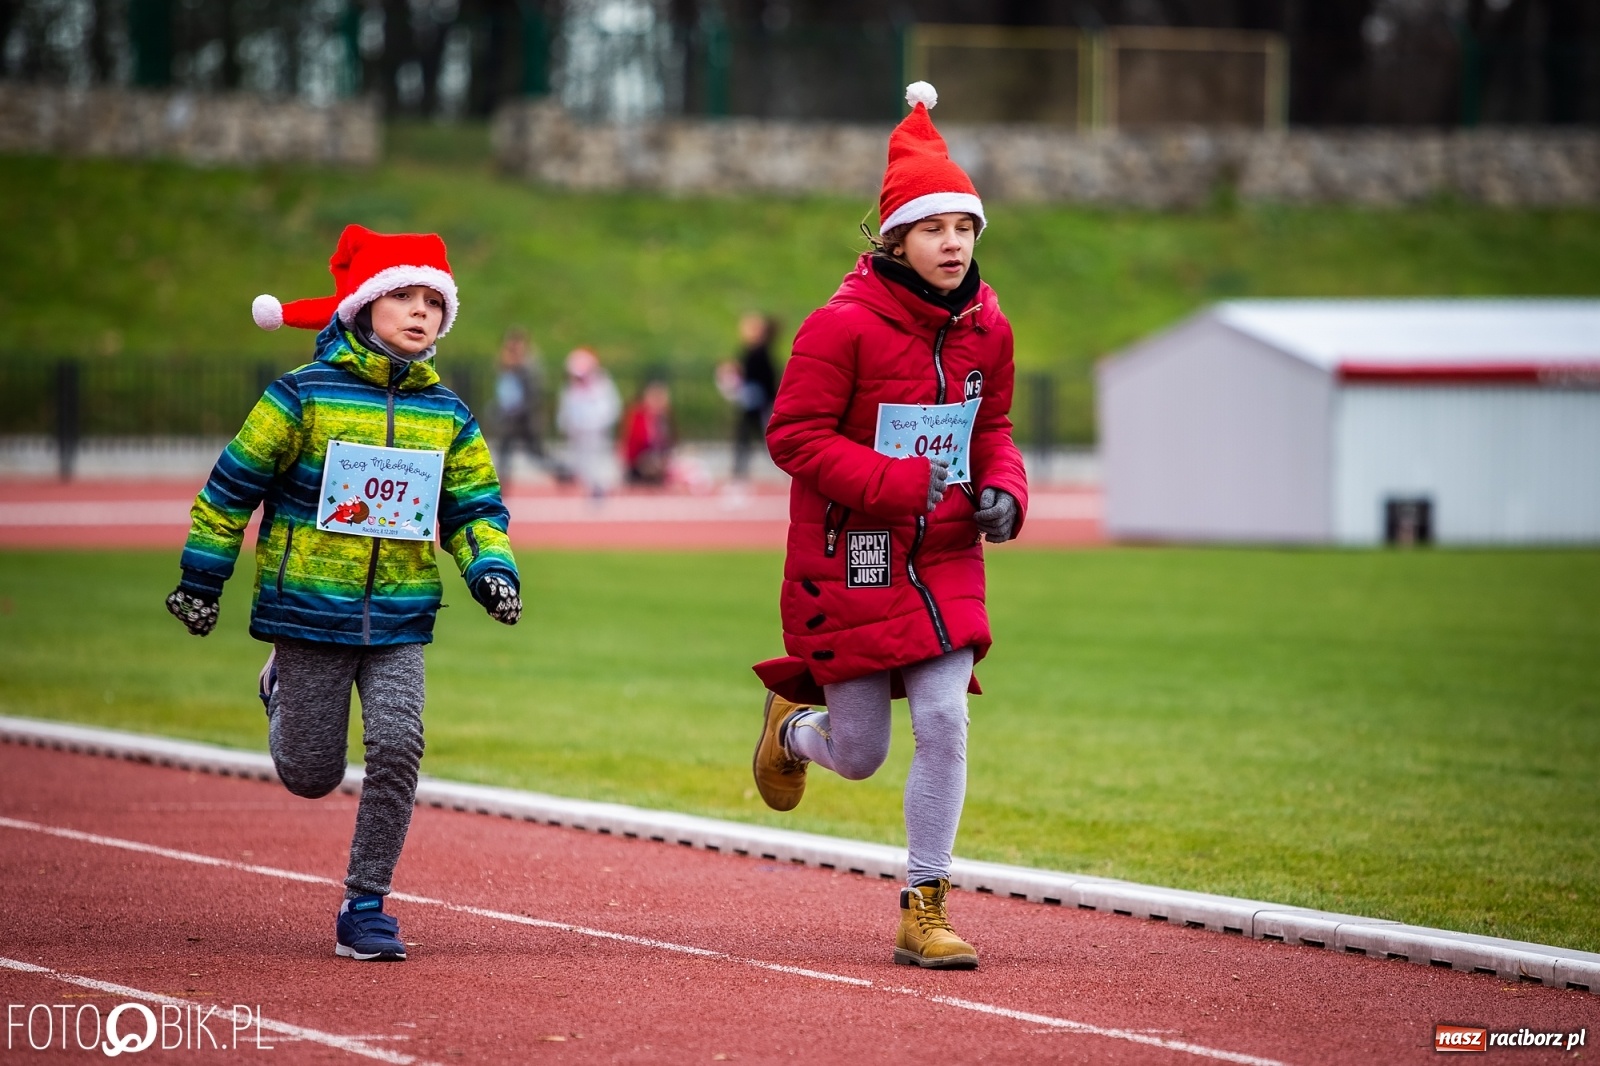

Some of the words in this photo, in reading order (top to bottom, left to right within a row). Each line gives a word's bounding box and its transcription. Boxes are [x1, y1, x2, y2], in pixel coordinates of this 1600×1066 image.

[914, 433, 953, 456] 044
[364, 477, 408, 502] 097
[850, 534, 887, 550] APPLY
[850, 550, 886, 565] SOME
[853, 568, 885, 584] JUST
